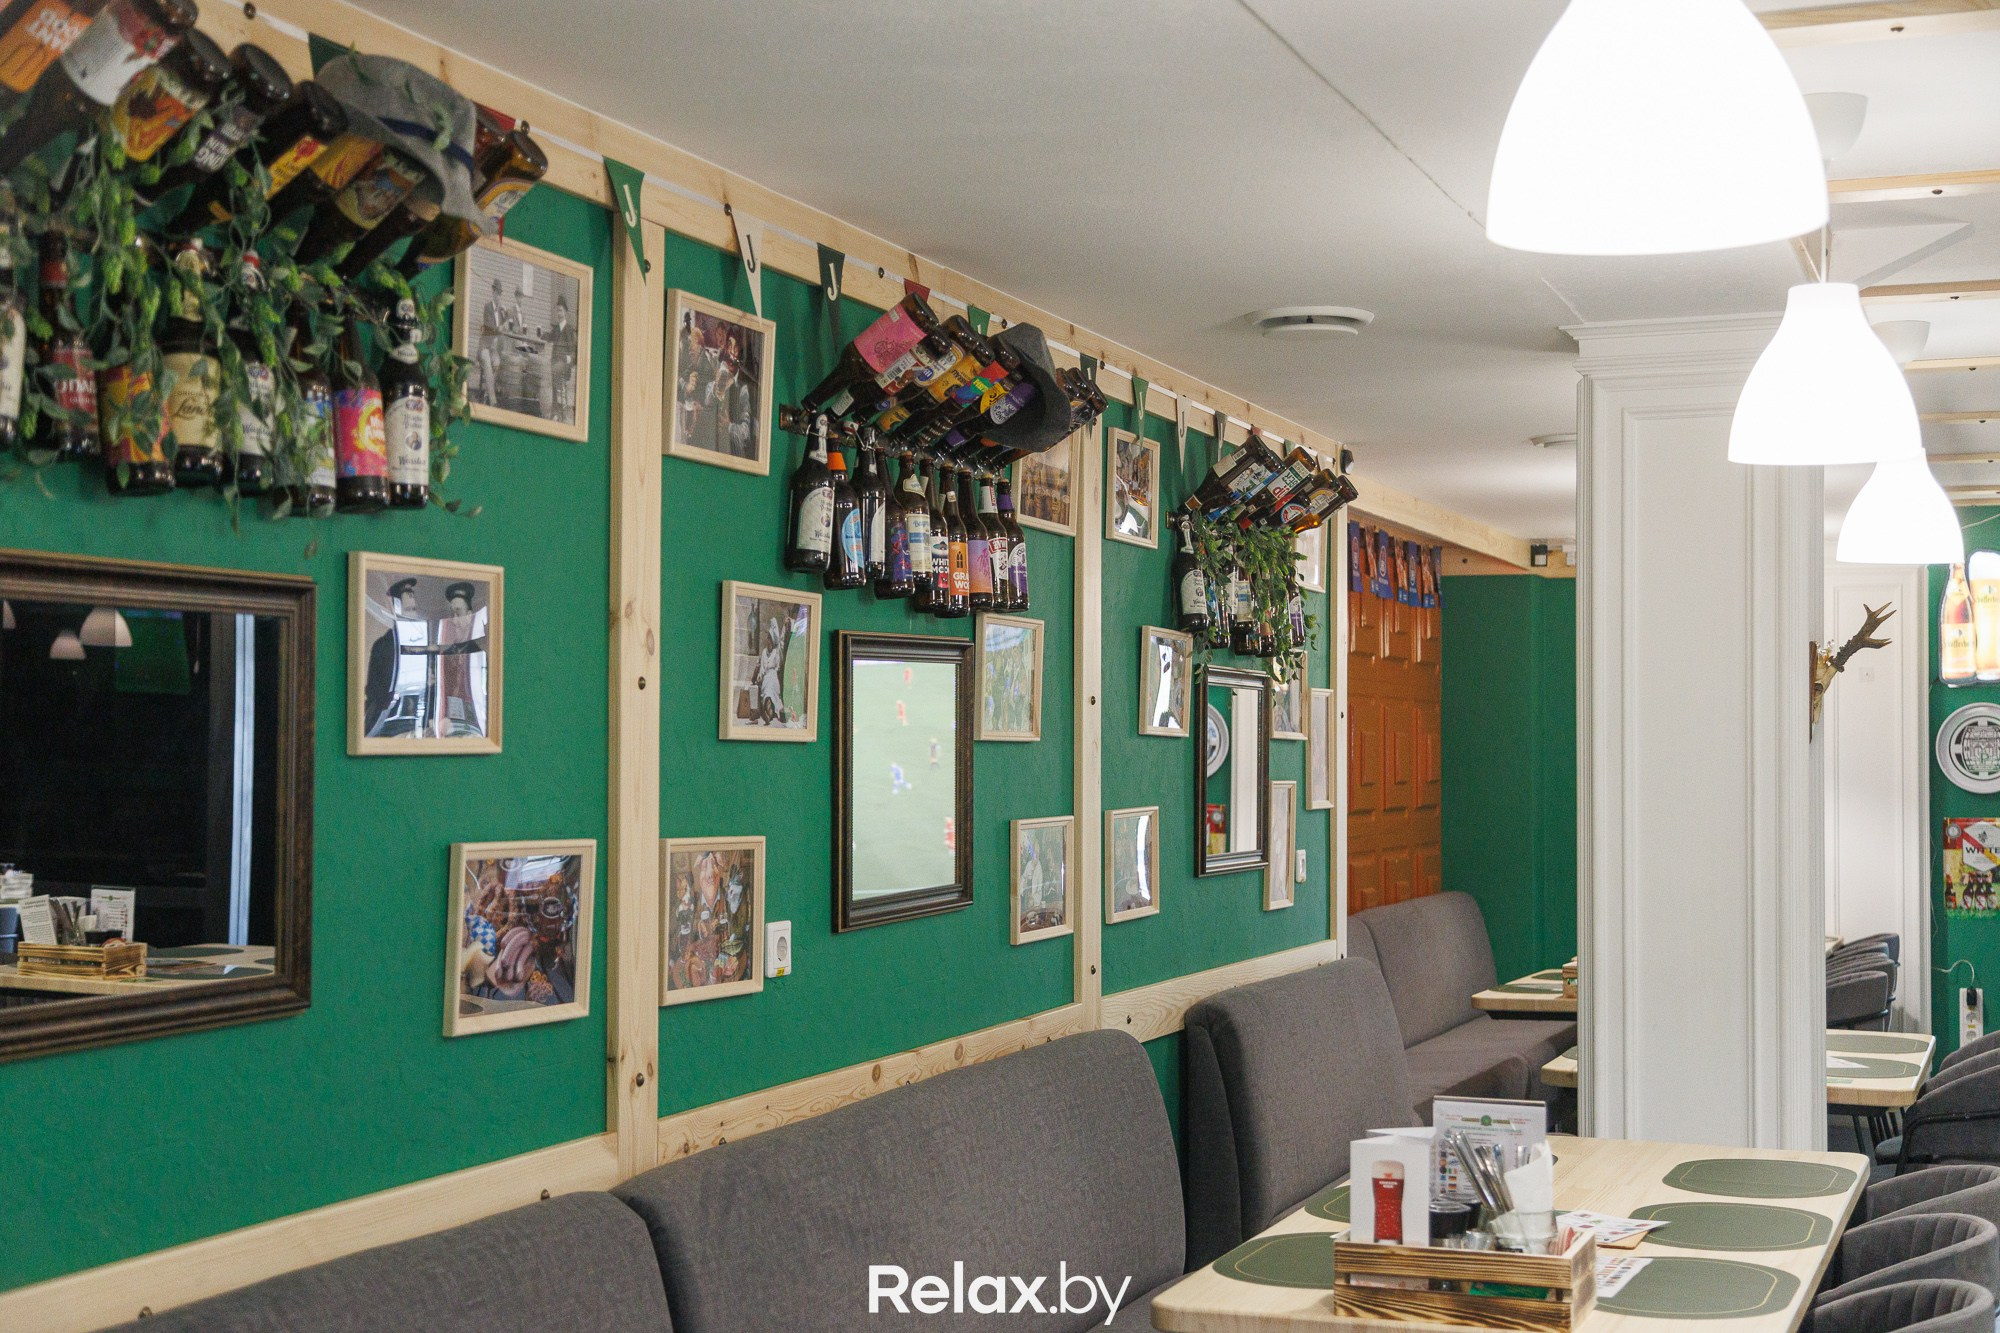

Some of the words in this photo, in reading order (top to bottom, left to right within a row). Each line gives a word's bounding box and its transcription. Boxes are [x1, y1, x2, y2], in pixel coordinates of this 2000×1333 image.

[622, 184, 637, 229] J
[746, 234, 756, 274] J
[827, 262, 839, 302] J
[1138, 391, 1144, 420] J
[1180, 411, 1186, 438] J
